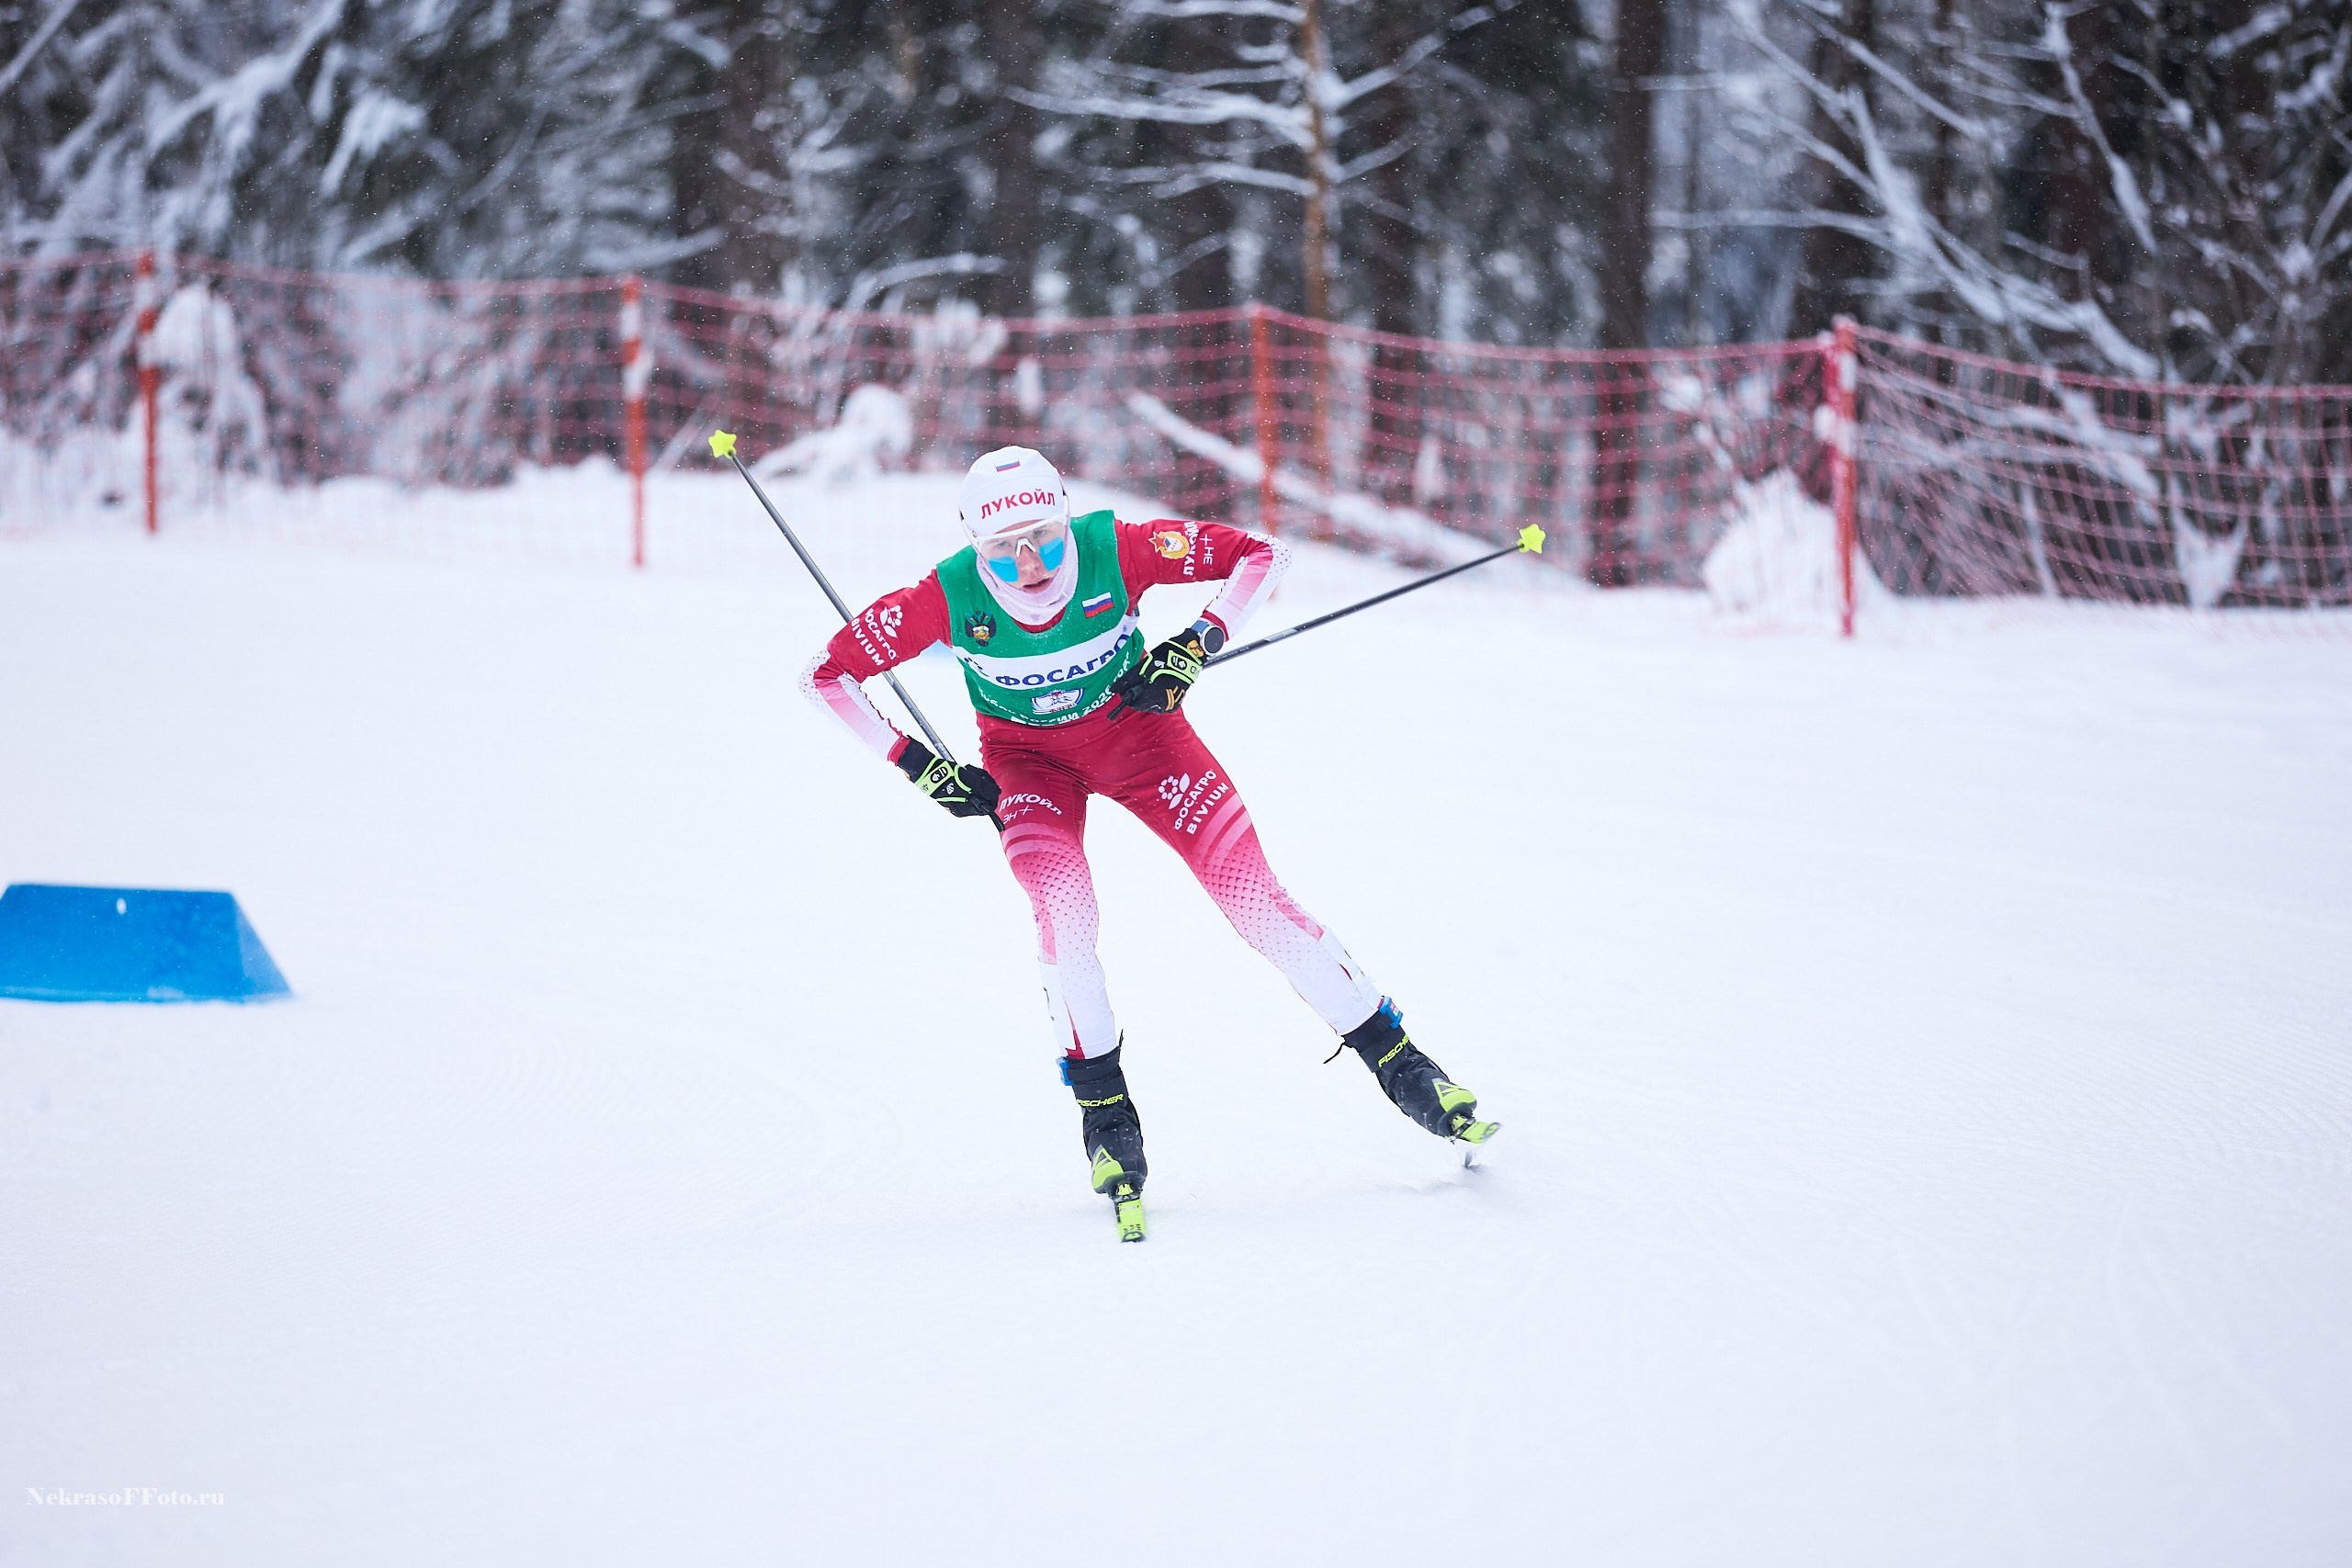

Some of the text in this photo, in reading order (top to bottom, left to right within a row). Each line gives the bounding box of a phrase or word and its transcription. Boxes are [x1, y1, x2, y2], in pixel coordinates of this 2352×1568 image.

[980, 488, 1056, 519] ЛУКОЙЛ
[851, 617, 886, 666] BIVIUM
[995, 634, 1130, 686] ФОСАГРО
[999, 793, 1063, 816] ЛУКОЙЛ
[1174, 770, 1217, 830] ФОСАГРО
[1186, 782, 1229, 835] BIVIUM
